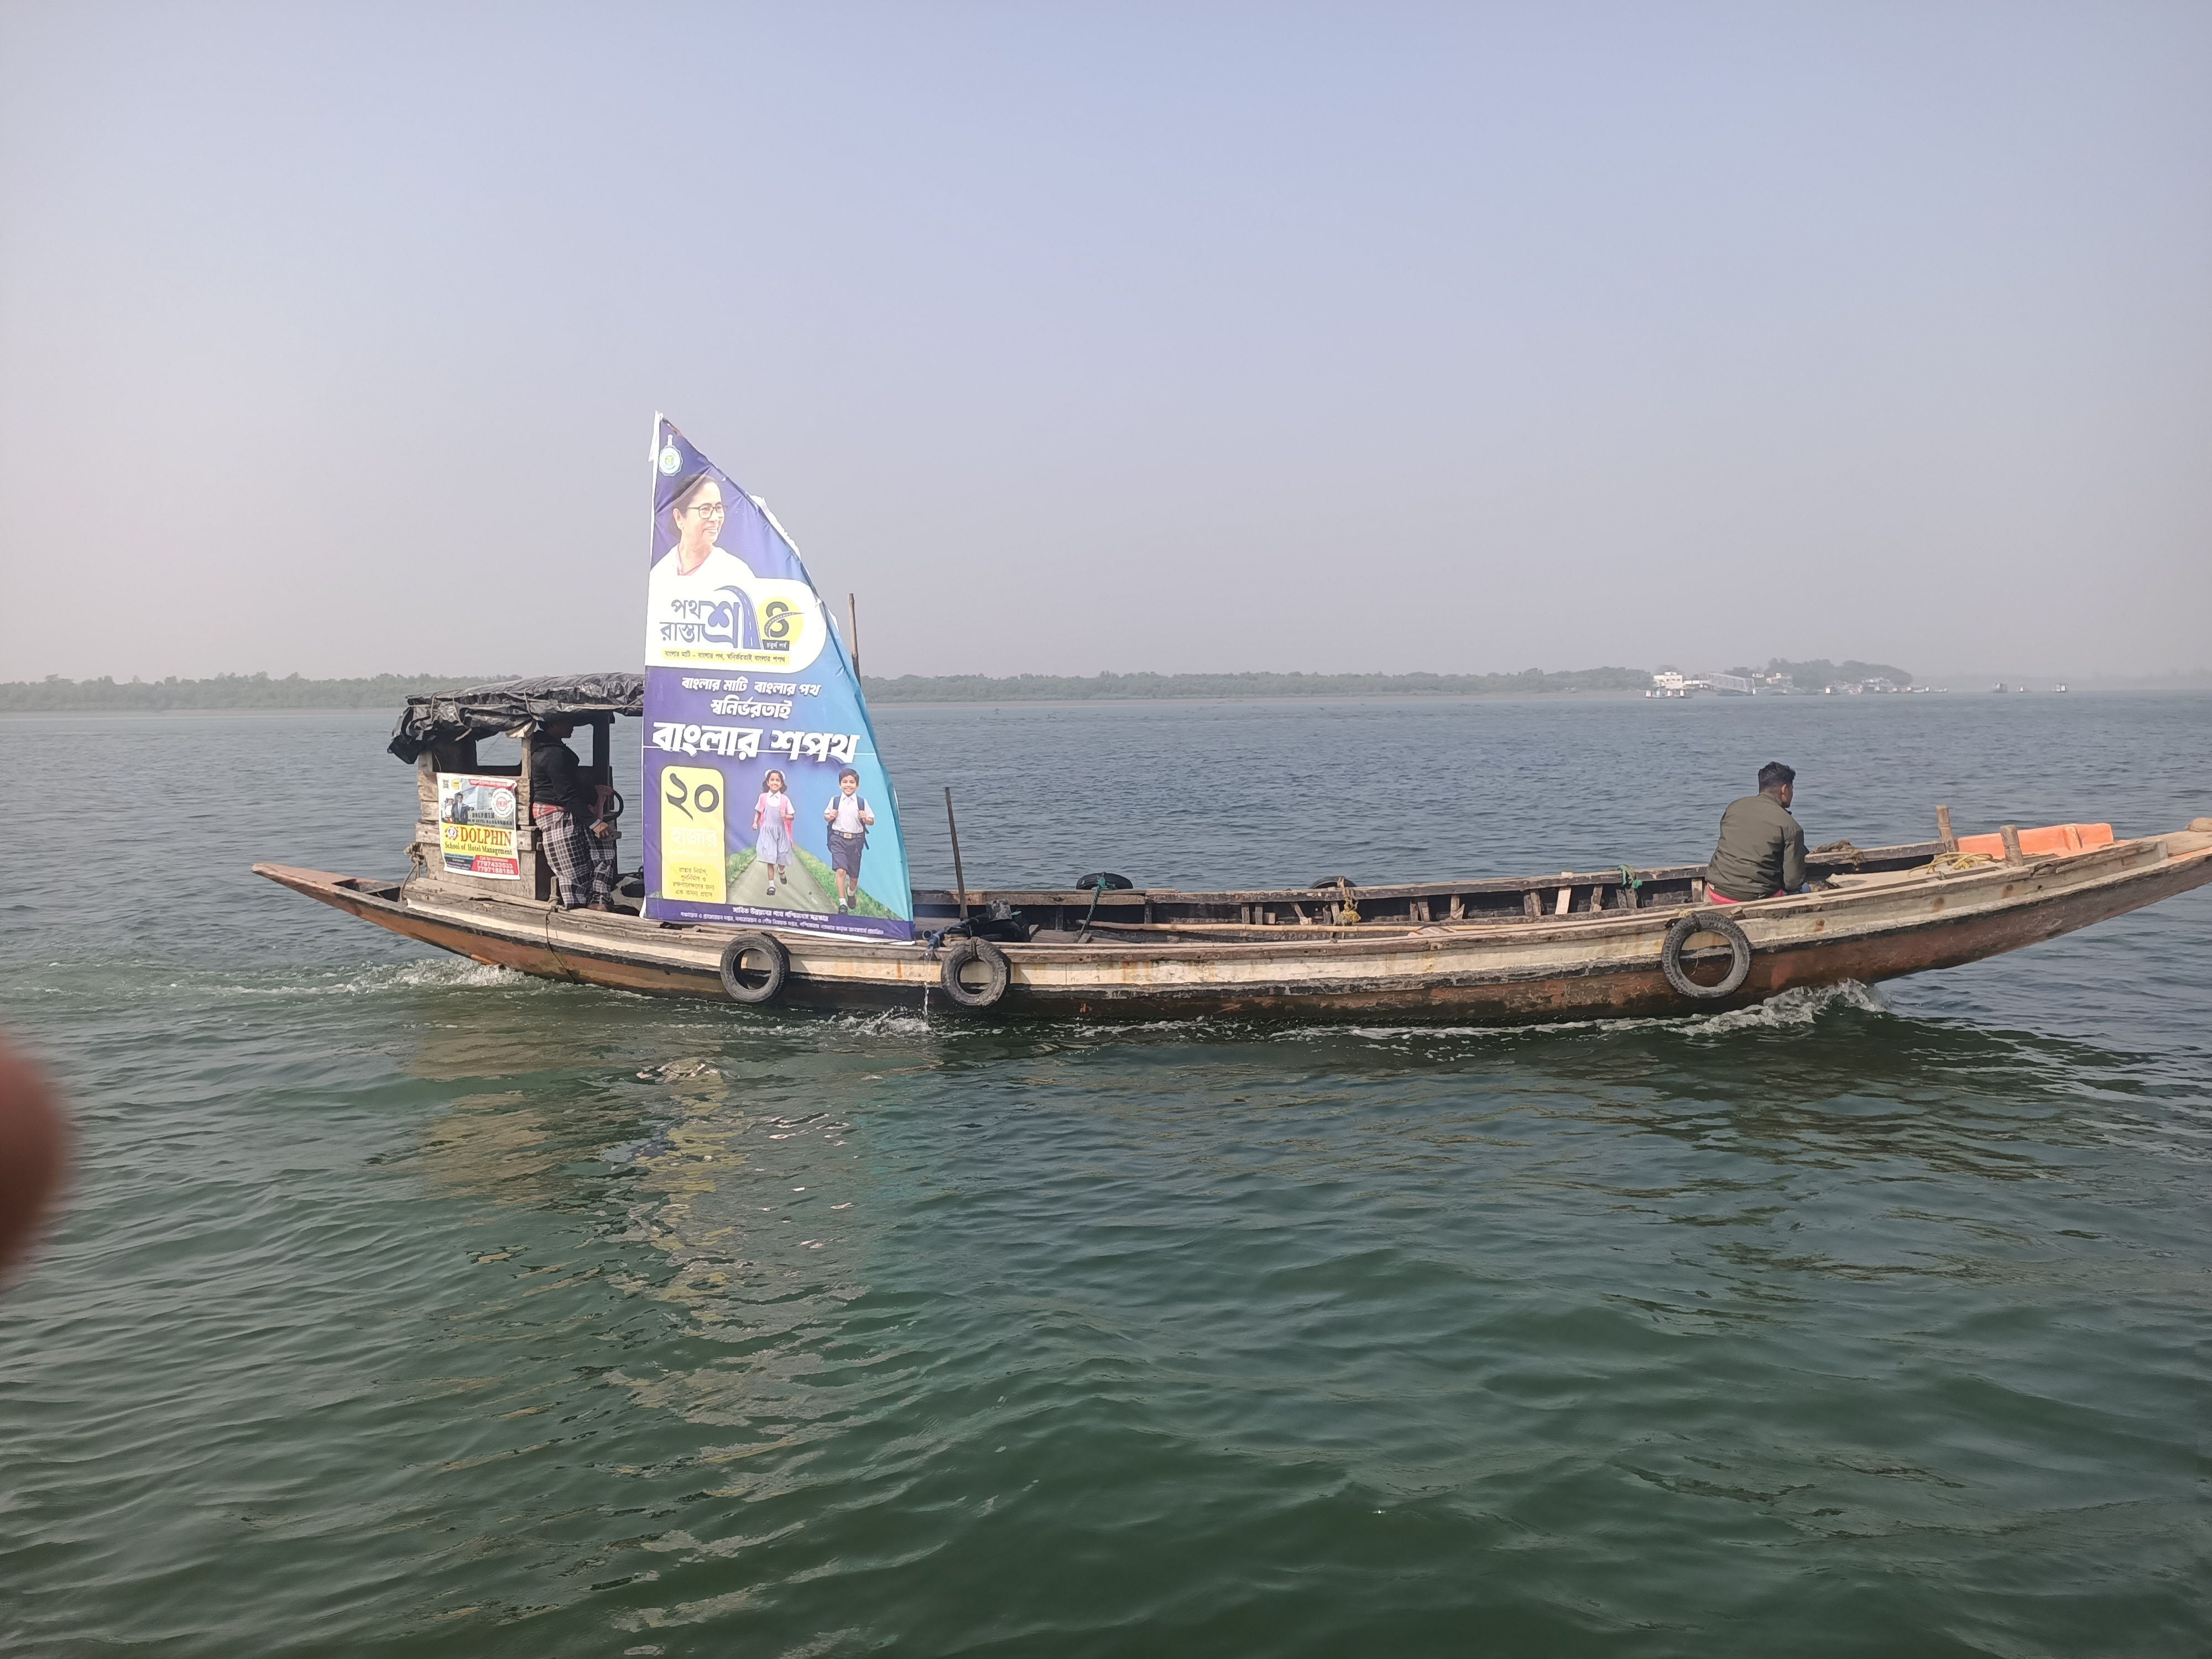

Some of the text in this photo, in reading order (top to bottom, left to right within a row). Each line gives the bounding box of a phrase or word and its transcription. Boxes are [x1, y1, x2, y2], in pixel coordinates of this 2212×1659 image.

[671, 599, 701, 619] পথ
[659, 622, 703, 643] রাস্তা
[682, 676, 821, 696] বাংলার মাটি বাংলার পথ
[711, 694, 792, 719] স্বনির্ভরতাই
[652, 722, 860, 764] বাংলার শপথ
[665, 773, 719, 821] ২০
[460, 827, 512, 847] DOLPHIN
[669, 827, 717, 848] হাজার
[445, 841, 460, 850] School
[468, 843, 481, 852] Hotel
[482, 846, 513, 855] Management
